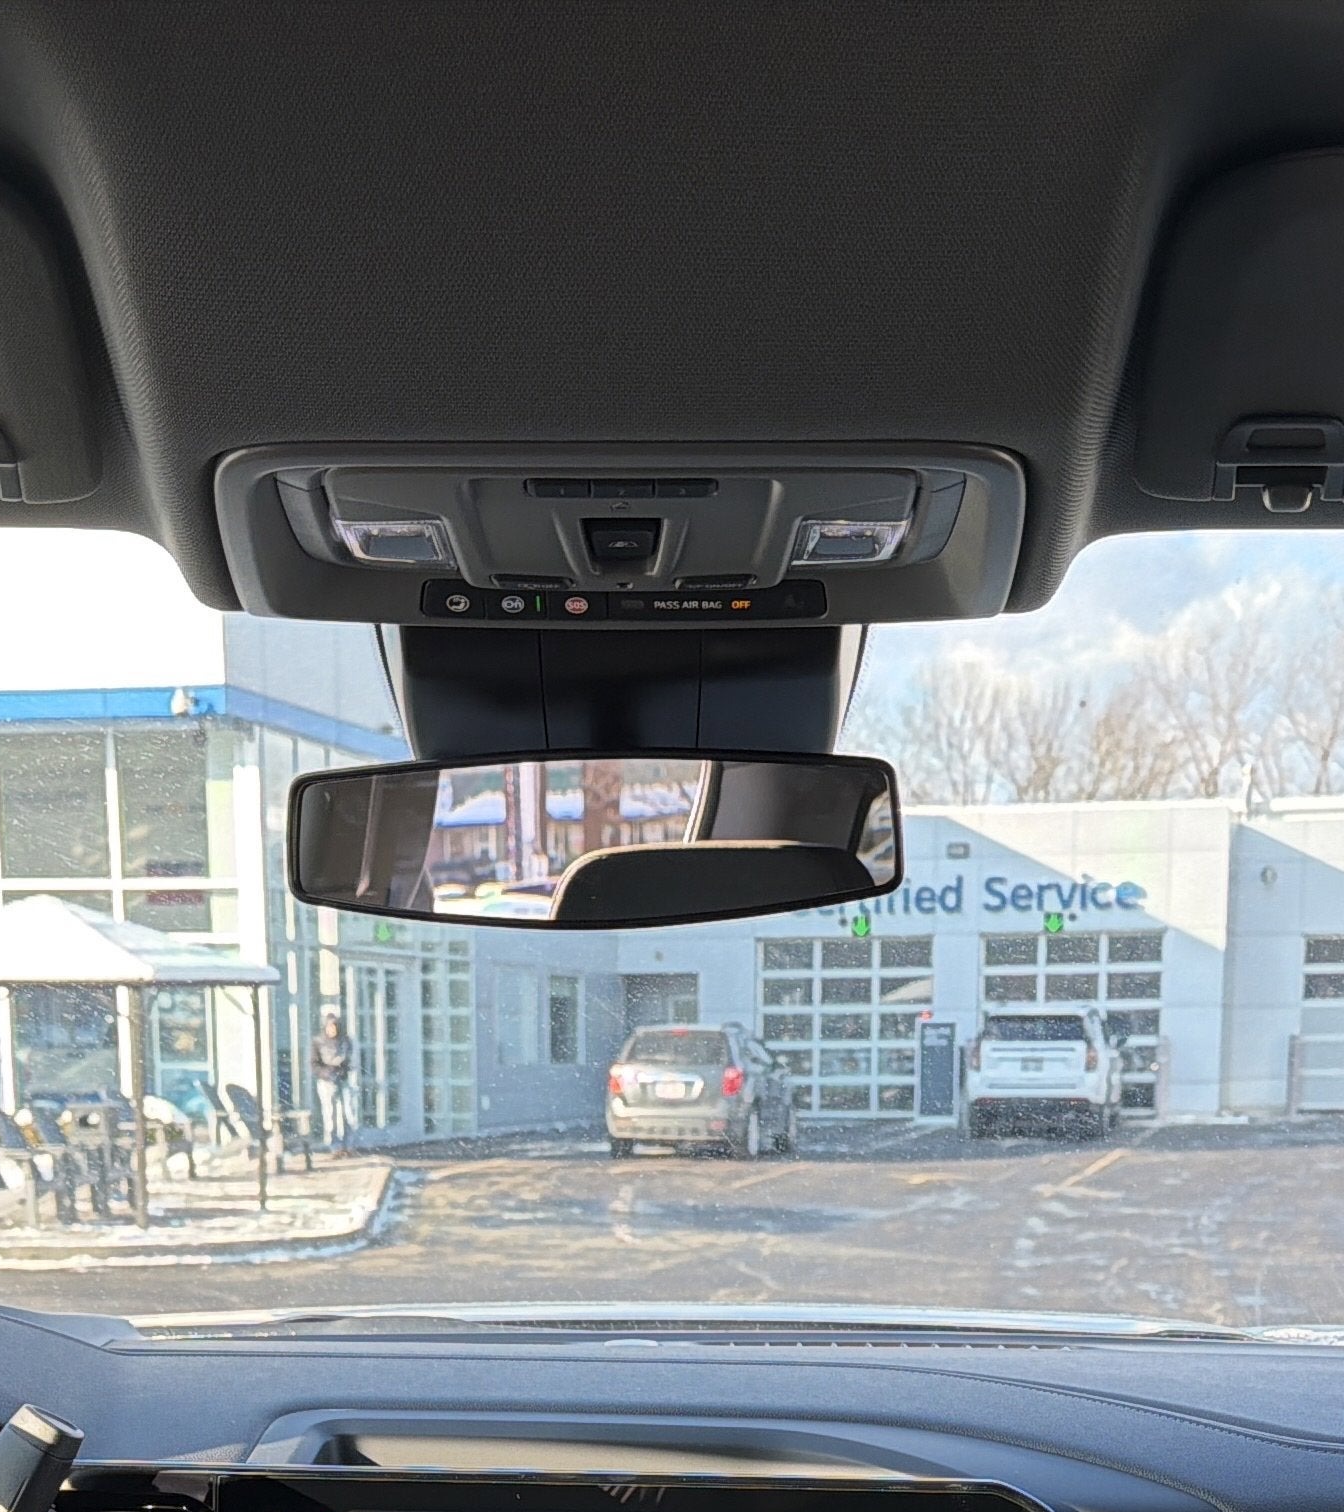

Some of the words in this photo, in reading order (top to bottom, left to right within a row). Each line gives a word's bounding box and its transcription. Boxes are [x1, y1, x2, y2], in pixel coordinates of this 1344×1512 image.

[567, 601, 586, 610] SOS
[654, 600, 679, 610] PASS
[681, 600, 699, 610] AIR
[702, 600, 722, 610] BAG
[731, 600, 751, 610] OFF
[983, 873, 1148, 914] Service
